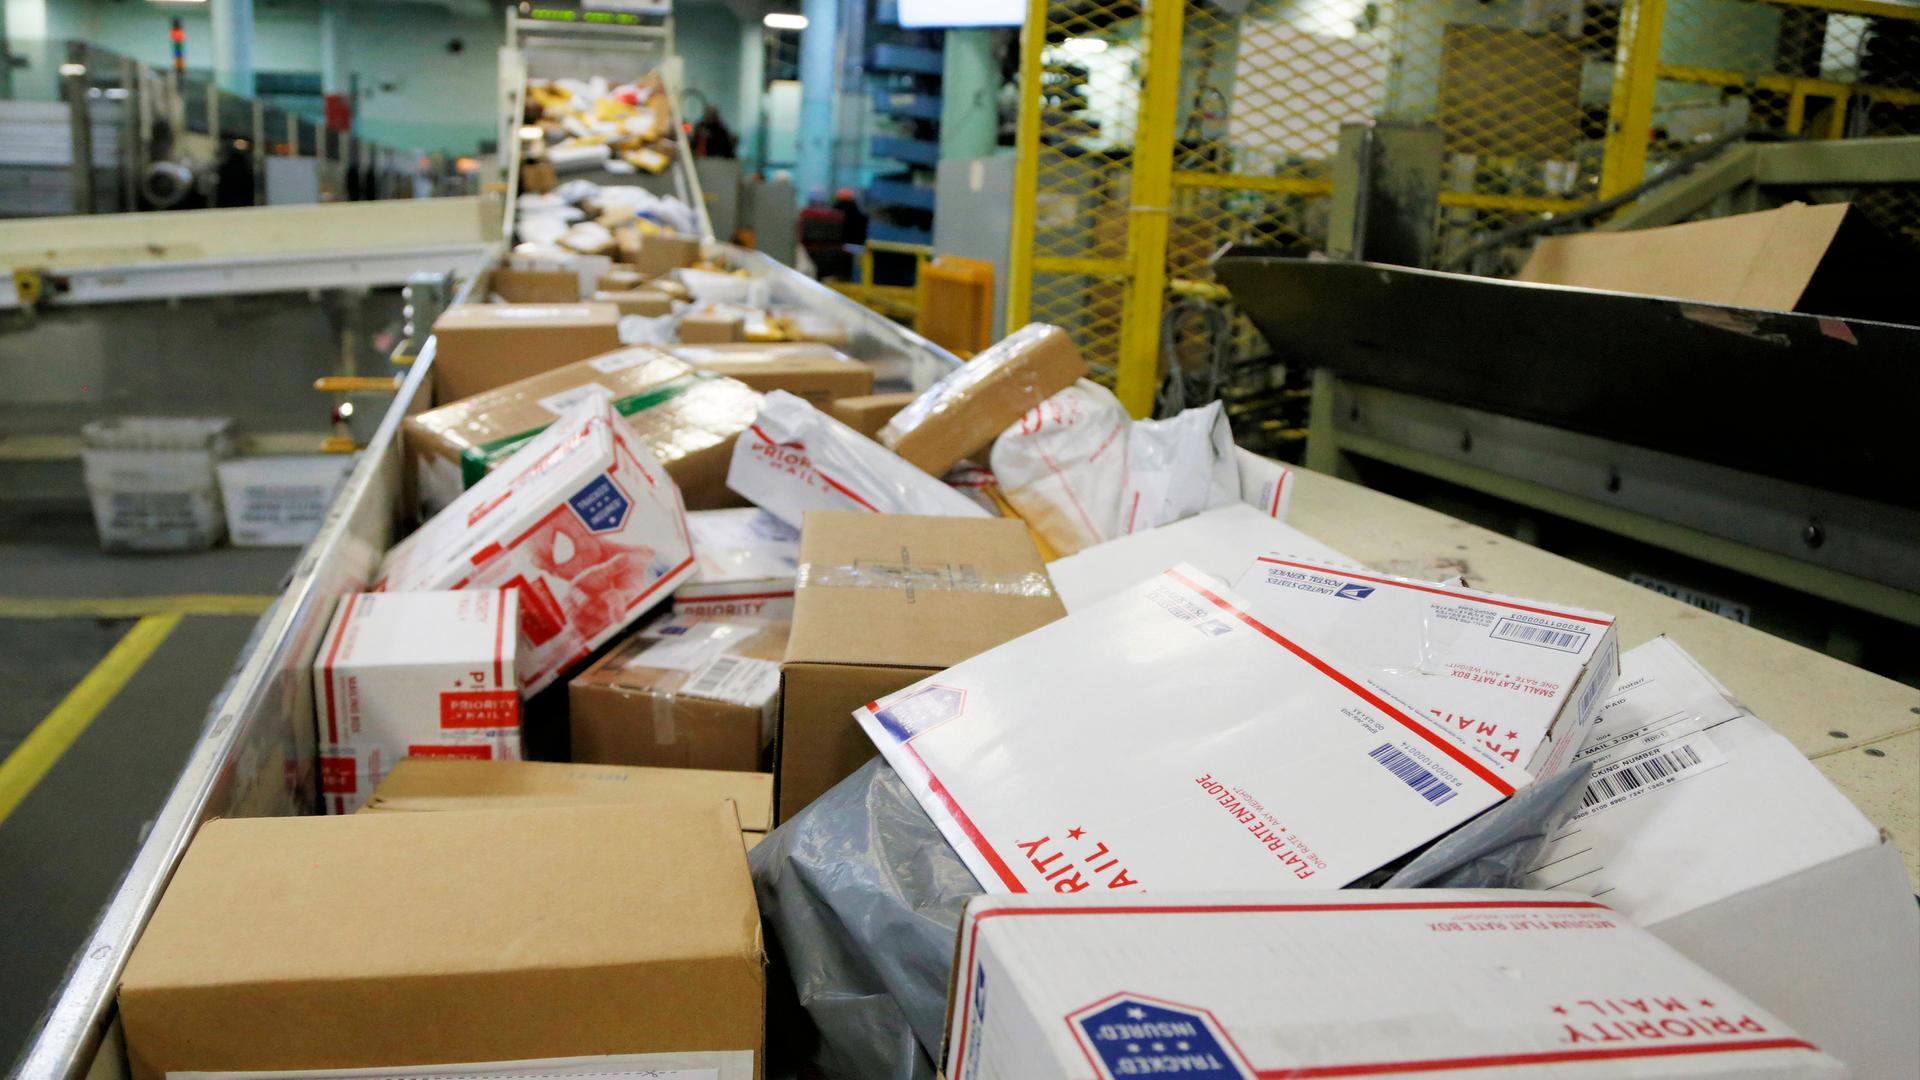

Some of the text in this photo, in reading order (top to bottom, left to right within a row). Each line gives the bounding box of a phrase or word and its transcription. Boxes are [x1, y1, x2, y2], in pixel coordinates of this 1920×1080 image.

[1266, 577, 1334, 595] UNITED STATES
[1309, 575, 1344, 587] POSTAL
[1451, 670, 1555, 698] SMALL FLAT RATE BOX
[1515, 676, 1538, 685] RATE
[1539, 681, 1559, 690] ONE
[451, 699, 515, 710] PRIORITY
[1605, 698, 1626, 710] PAID
[1585, 743, 1611, 755] MAIL
[1614, 731, 1640, 744] 3-Day
[1591, 748, 1660, 779] CKING NUMBER
[1195, 774, 1315, 880] FLAT RATE ENVELOPE
[1262, 812, 1280, 827] ANY
[1287, 834, 1310, 854] RATE
[1307, 852, 1327, 869] ONE
[1426, 920, 1616, 931] MEDIUM FLAT RATE BOX
[1577, 997, 1689, 1015] MAIL
[1100, 1022, 1197, 1040] INSURED
[1561, 1014, 1767, 1043] PRIORITY
[1117, 1053, 1223, 1075] TRACKED
